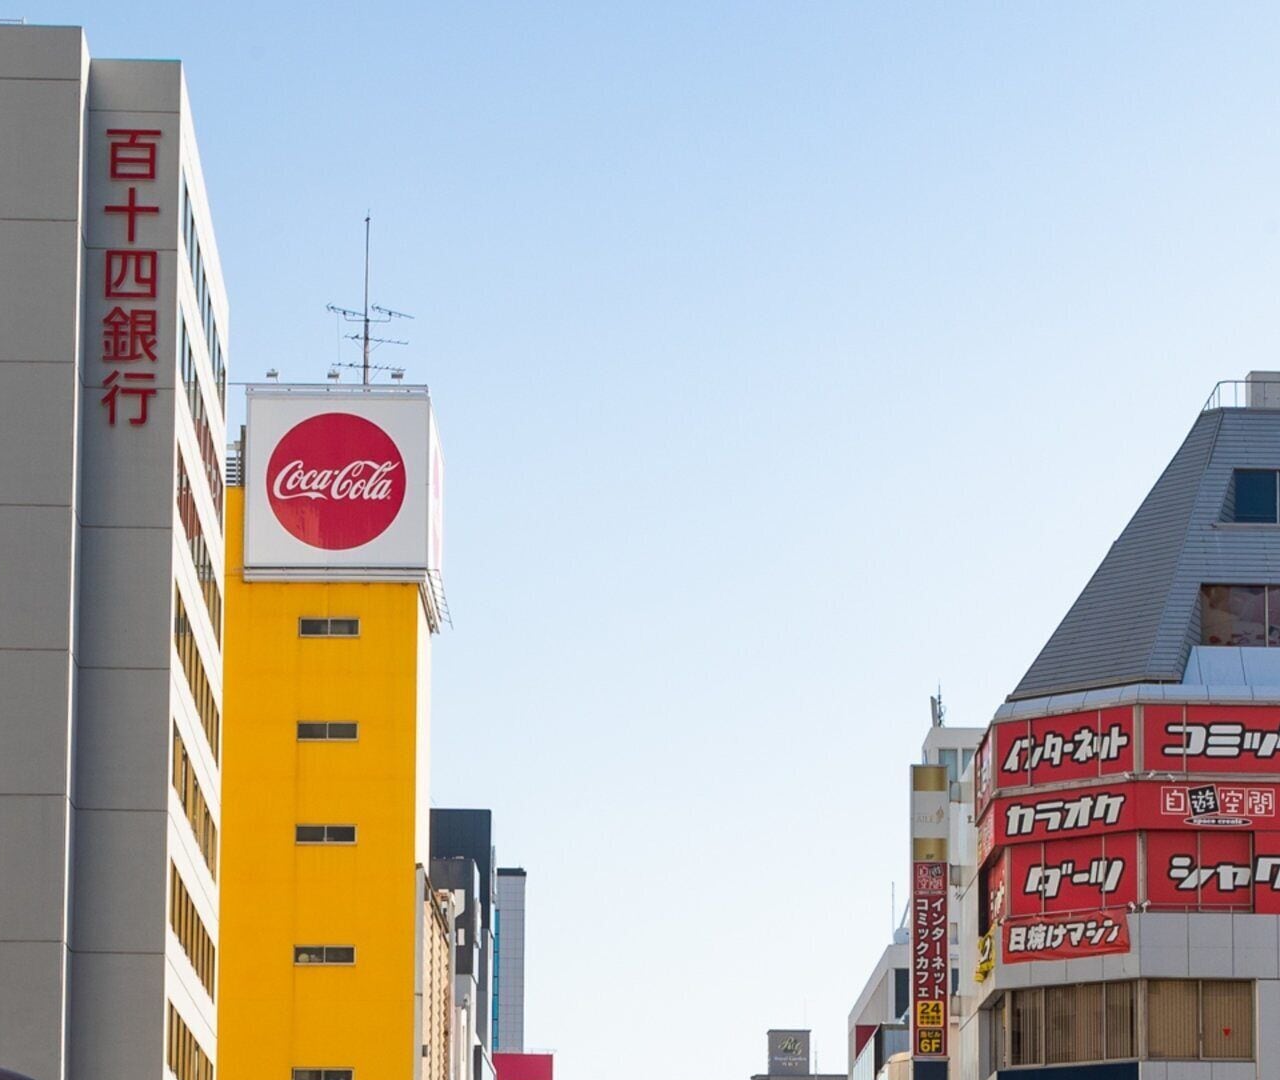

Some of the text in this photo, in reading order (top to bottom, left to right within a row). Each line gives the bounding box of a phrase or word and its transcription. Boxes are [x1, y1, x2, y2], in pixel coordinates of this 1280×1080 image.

[101, 128, 162, 428] 百十四銀行
[272, 458, 400, 501] Coca-Cola
[1003, 725, 1128, 772] インターネット
[1006, 794, 1125, 836] カラオケ
[1162, 785, 1275, 816] 自遊空間
[1024, 859, 1124, 898] ダーツ
[916, 898, 929, 998] コミックカフェ
[931, 897, 945, 1000] インターネット
[1008, 919, 1122, 952] 日焼けマシン
[920, 1002, 941, 1015] 24
[920, 1039, 941, 1053] 6F
